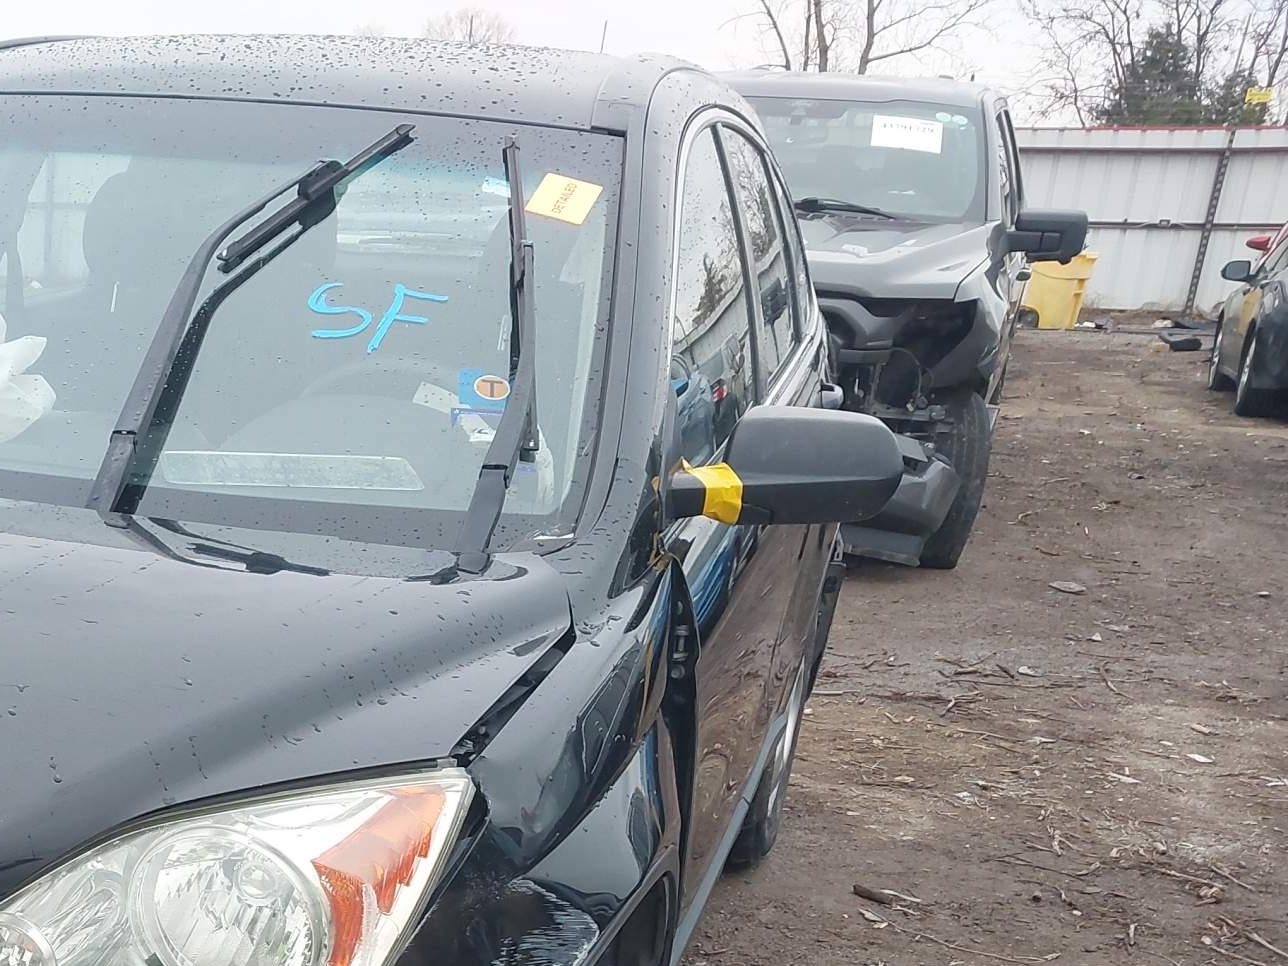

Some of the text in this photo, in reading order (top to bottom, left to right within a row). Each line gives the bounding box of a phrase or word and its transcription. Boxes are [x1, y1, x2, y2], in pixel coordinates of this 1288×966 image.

[551, 183, 578, 214] DETAILED
[308, 282, 449, 352] SF
[481, 379, 504, 398] T
